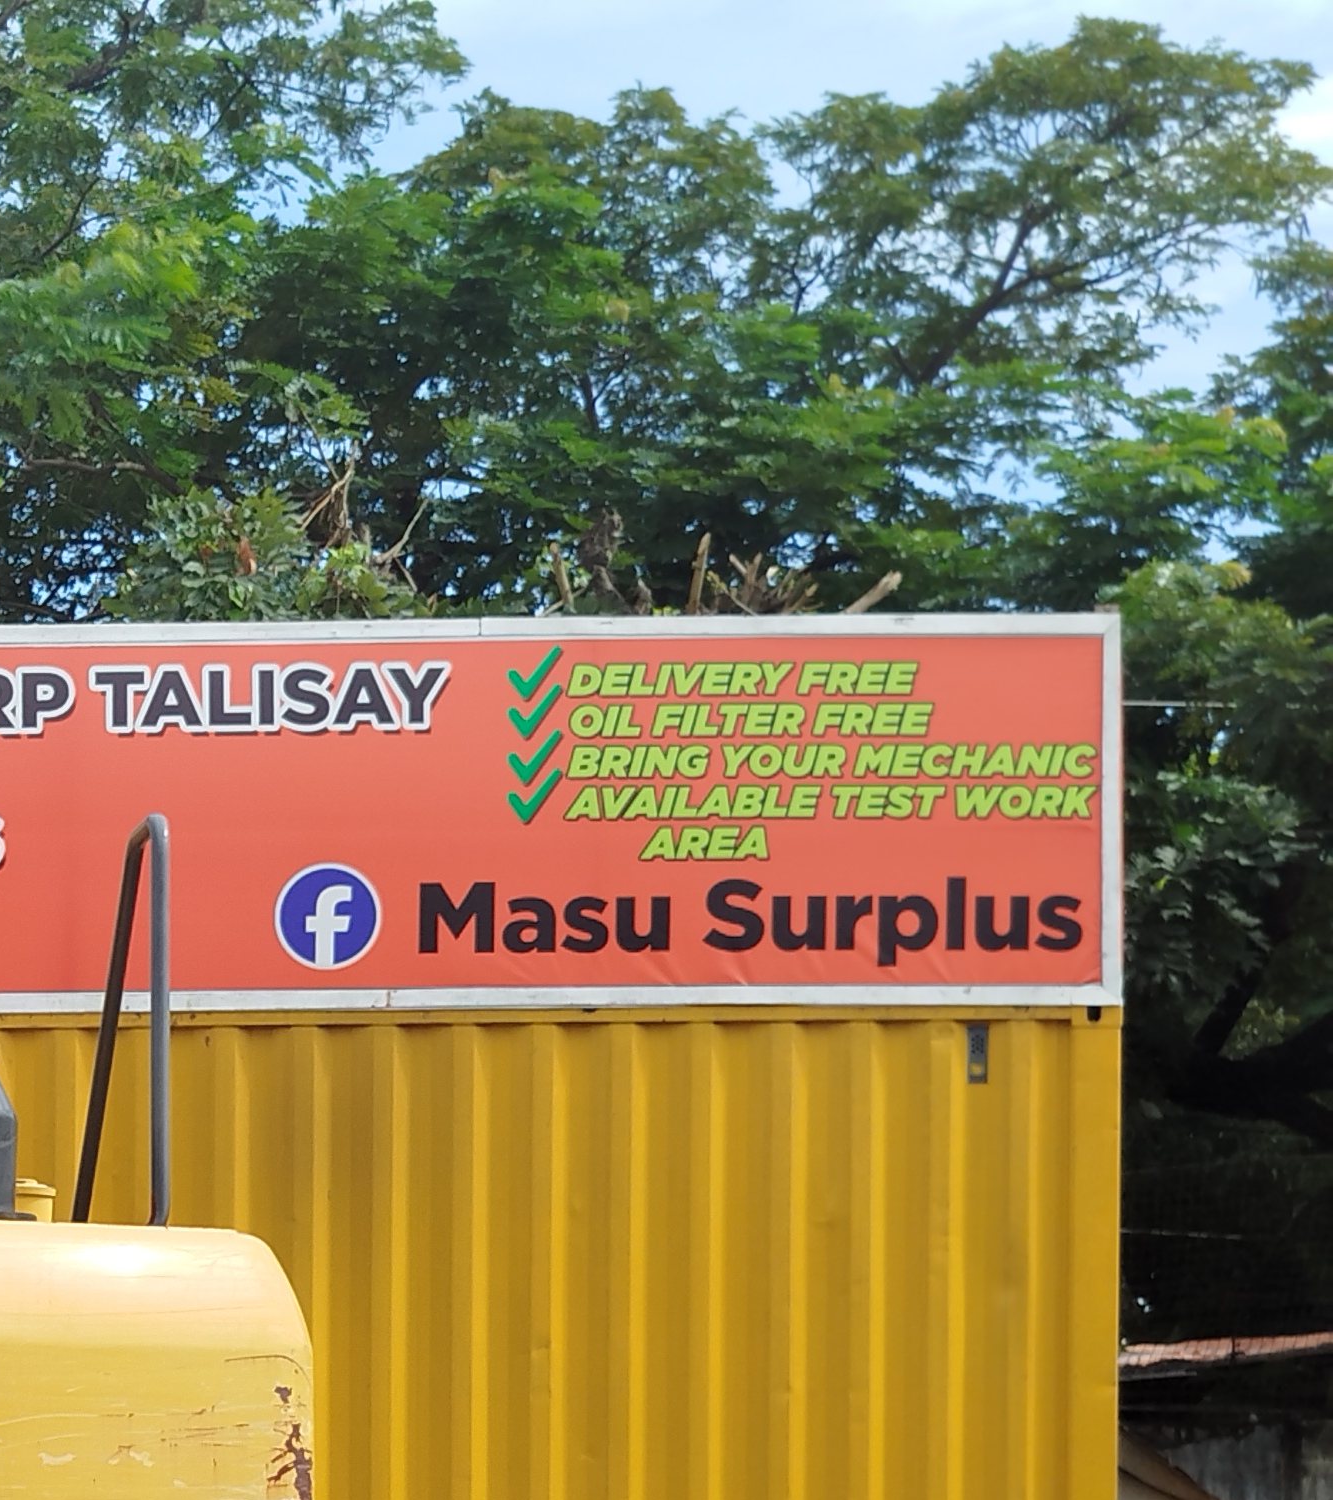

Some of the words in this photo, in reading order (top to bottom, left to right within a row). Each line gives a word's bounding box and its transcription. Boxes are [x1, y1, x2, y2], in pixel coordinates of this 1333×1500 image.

[92, 664, 448, 730] TALISAY
[566, 662, 795, 697] DELIVERY
[797, 661, 919, 695] FREE
[569, 704, 641, 738] OIL
[653, 703, 806, 737] FILTER
[813, 702, 933, 736] FREE
[567, 745, 708, 779] BRING
[722, 744, 844, 778] YOUR
[854, 743, 1097, 778] MECHANIC
[564, 785, 818, 820] AVAILABLE
[832, 785, 946, 819] TEST
[953, 784, 1097, 819] WORK
[639, 825, 769, 861] AREA
[418, 880, 671, 953] Masu
[702, 875, 1083, 967] Surplus
